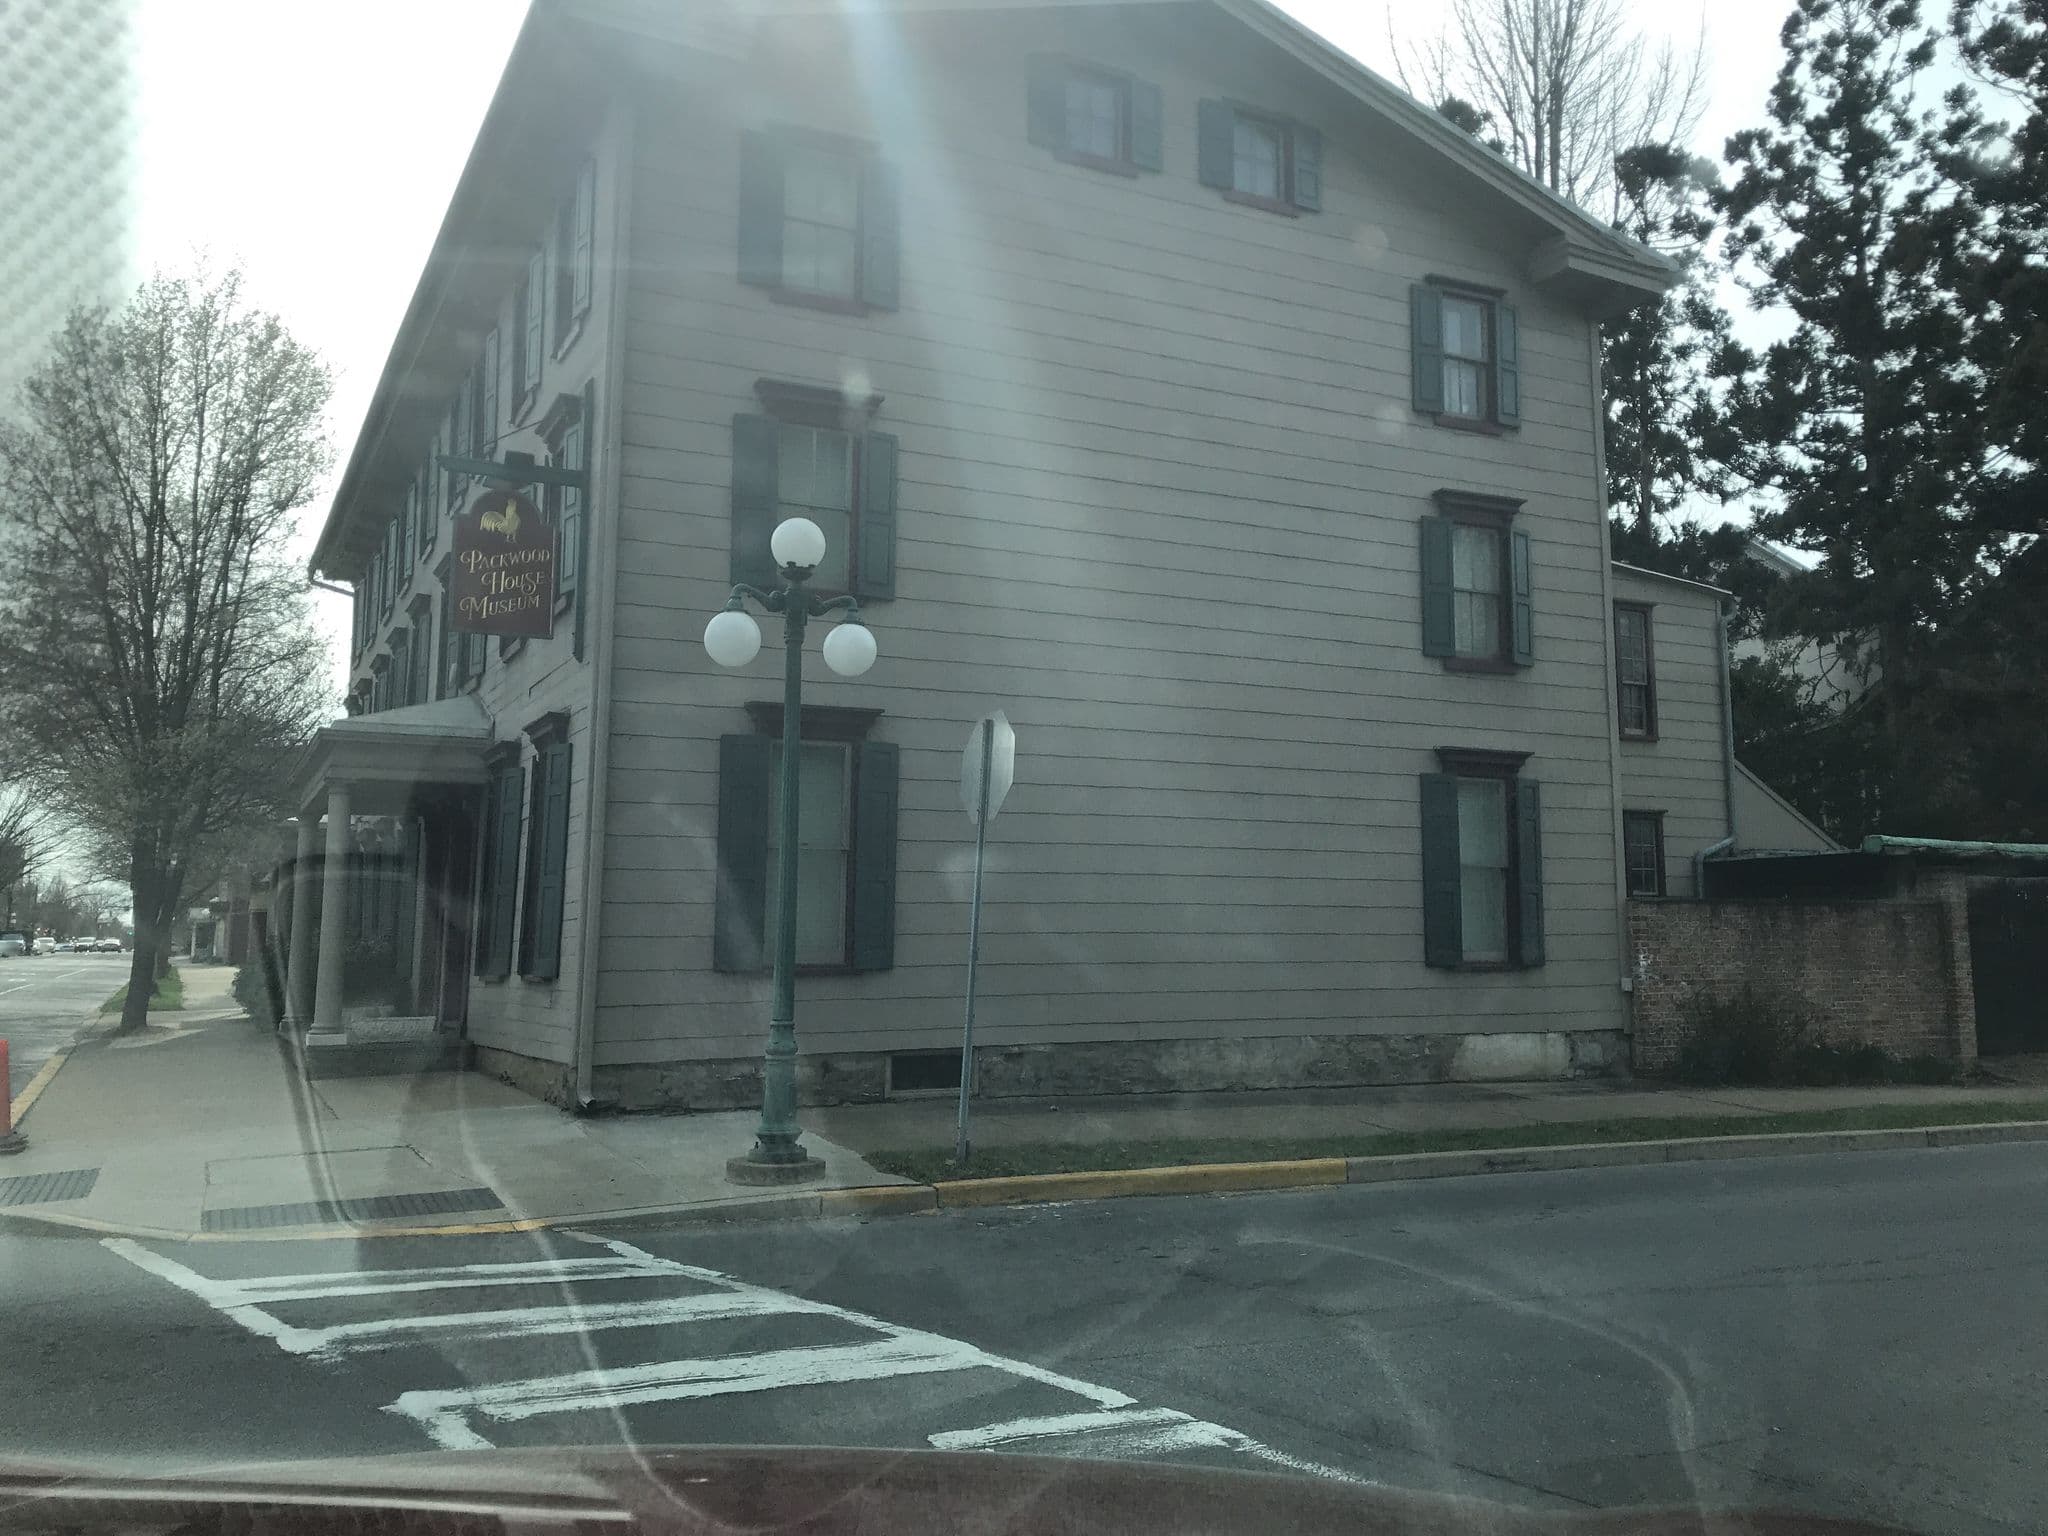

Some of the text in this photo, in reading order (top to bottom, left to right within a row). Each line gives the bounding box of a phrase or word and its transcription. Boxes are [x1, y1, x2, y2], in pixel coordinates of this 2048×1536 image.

[460, 549, 550, 573] PACKWOOD
[481, 570, 545, 595] HOUSE
[459, 594, 541, 620] MUSEUM
